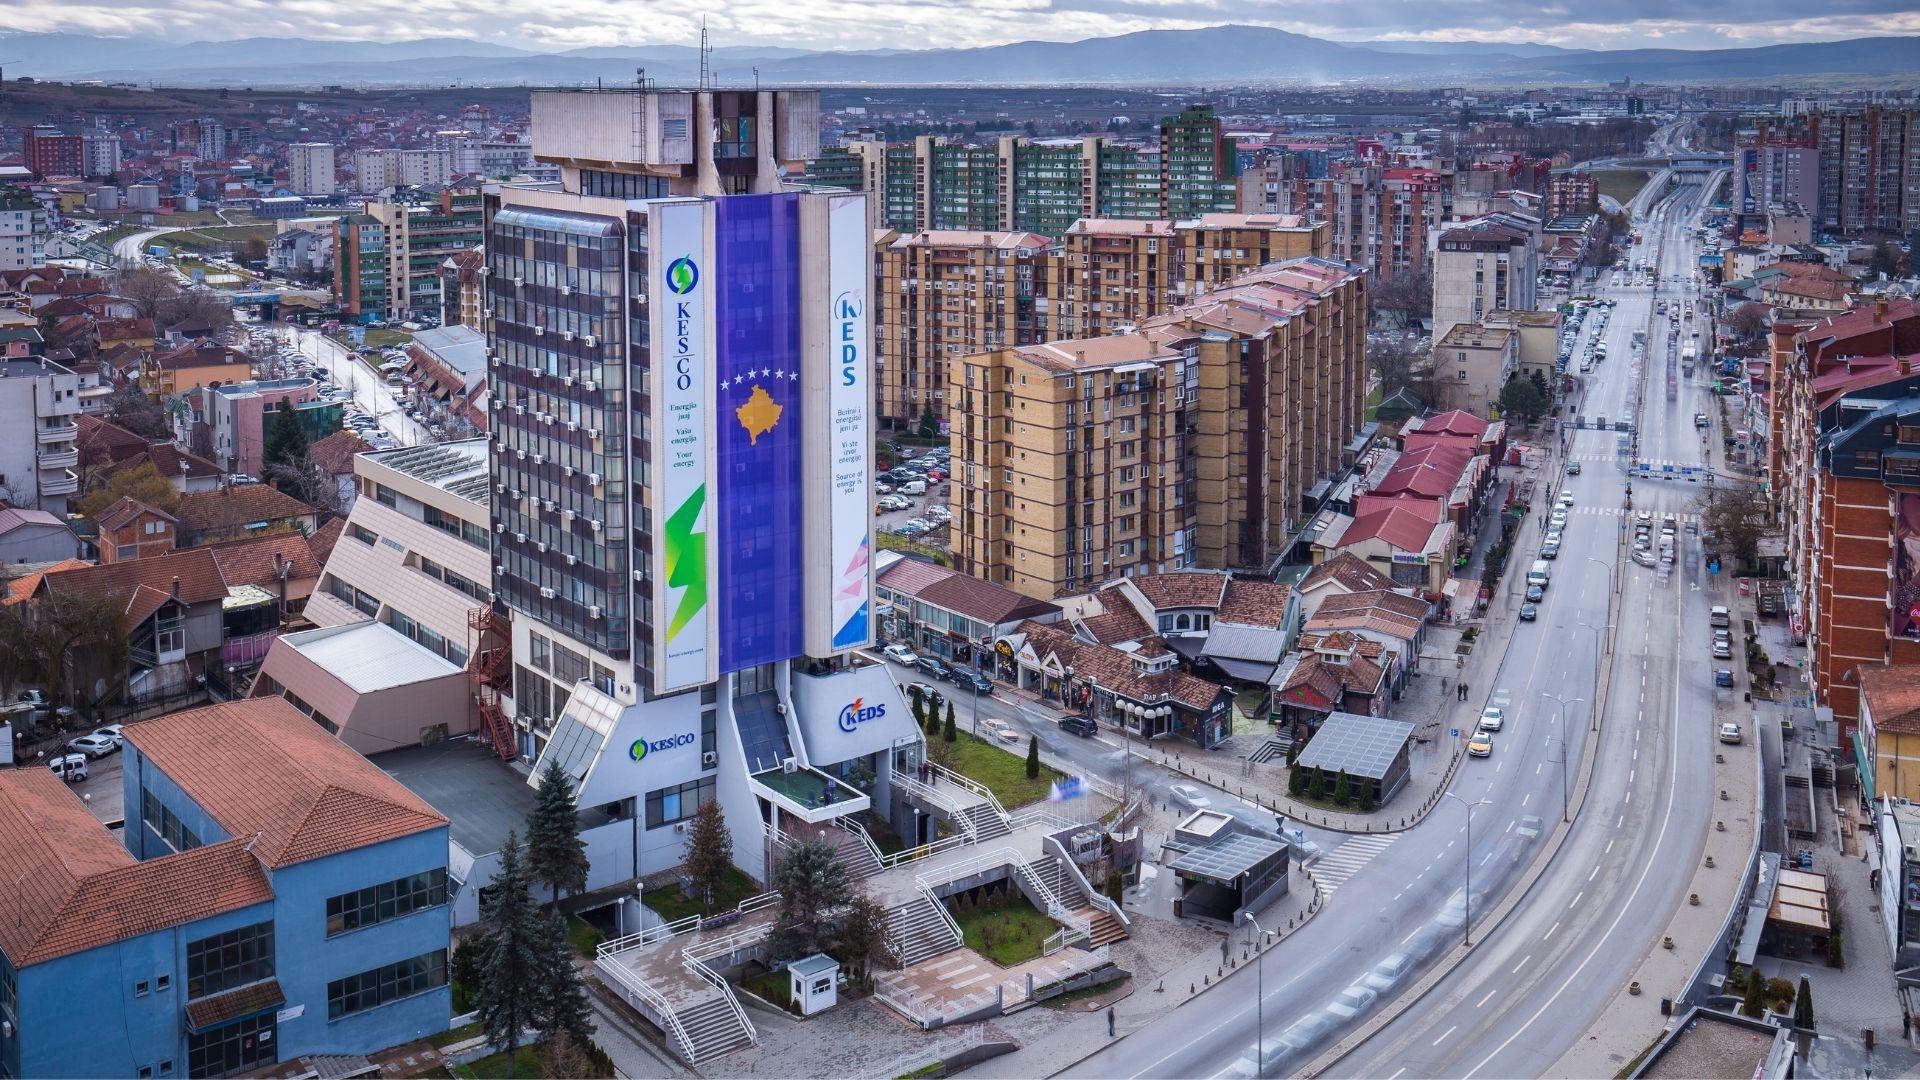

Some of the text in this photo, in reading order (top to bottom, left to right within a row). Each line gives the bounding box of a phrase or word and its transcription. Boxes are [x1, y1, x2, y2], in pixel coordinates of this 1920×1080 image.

[842, 299, 858, 387] KEDS
[835, 469, 863, 481] Source of
[836, 480, 856, 489] energy
[844, 487, 855, 496] you
[1211, 701, 1225, 714] IDEA
[845, 703, 886, 726] KEDS
